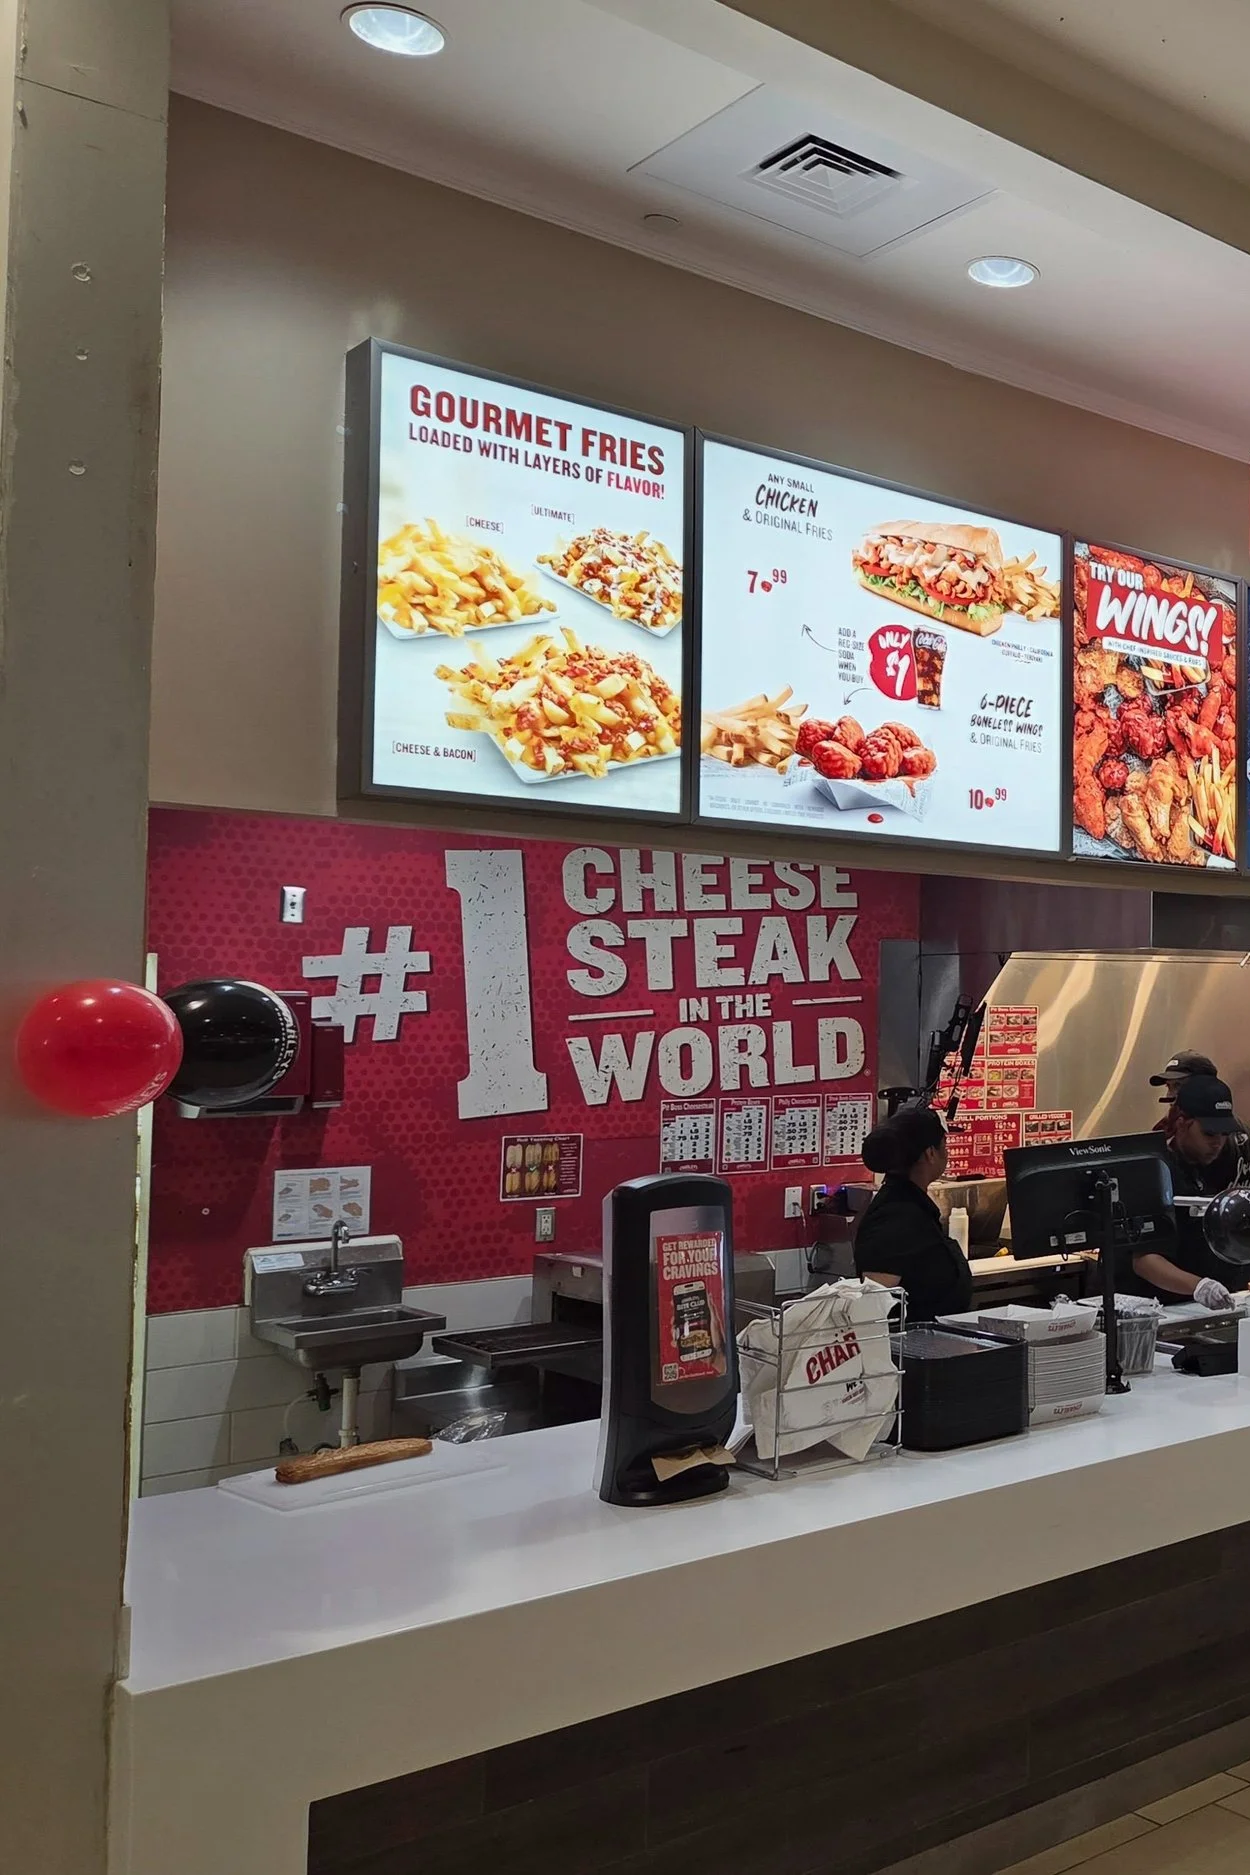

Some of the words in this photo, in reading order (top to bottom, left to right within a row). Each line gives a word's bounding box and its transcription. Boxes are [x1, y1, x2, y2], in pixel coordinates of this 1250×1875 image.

[409, 384, 573, 452] GOURMET
[581, 429, 665, 475] FRIES
[409, 423, 472, 453] LOADED
[477, 439, 519, 464] WITH
[524, 450, 580, 479] LAYERS
[584, 466, 603, 485] OF
[607, 471, 665, 499] FLAVOR!
[768, 473, 784, 485] ANY
[787, 478, 814, 493] SMALL
[755, 484, 818, 518] CHICKEN
[743, 509, 752, 522] &
[755, 511, 802, 534] ORIGINAL
[806, 522, 833, 541] FRIES
[1089, 562, 1115, 583] TRY
[1117, 569, 1144, 590] OUR
[1096, 584, 1217, 656] WINGS!
[838, 627, 851, 637] ADD
[852, 630, 856, 638] A
[878, 631, 910, 649] ONLY
[838, 649, 854, 660] SODA
[852, 641, 864, 651] SIZE
[838, 660, 856, 671] WHEN
[886, 650, 910, 697] $1
[852, 675, 864, 683] BUY
[980, 693, 1034, 718] 6-PIECE
[970, 714, 1013, 733] BONELESS
[1016, 720, 1044, 737] WINGS
[433, 745, 441, 757] &
[970, 732, 977, 744] &
[980, 734, 1017, 751] ORIGINAL
[1019, 739, 1042, 753] FRIES
[562, 847, 859, 916] CHEESE
[567, 915, 861, 997] STEAK
[680, 997, 710, 1023] IN
[716, 992, 772, 1020] THE
[566, 1016, 865, 1107] WORLD
[1069, 1144, 1112, 1157] ViewSonic
[663, 1242, 677, 1251] GET
[663, 1251, 686, 1266] FOR
[688, 1248, 717, 1263] YOUR
[663, 1262, 718, 1280] CRAVINGS
